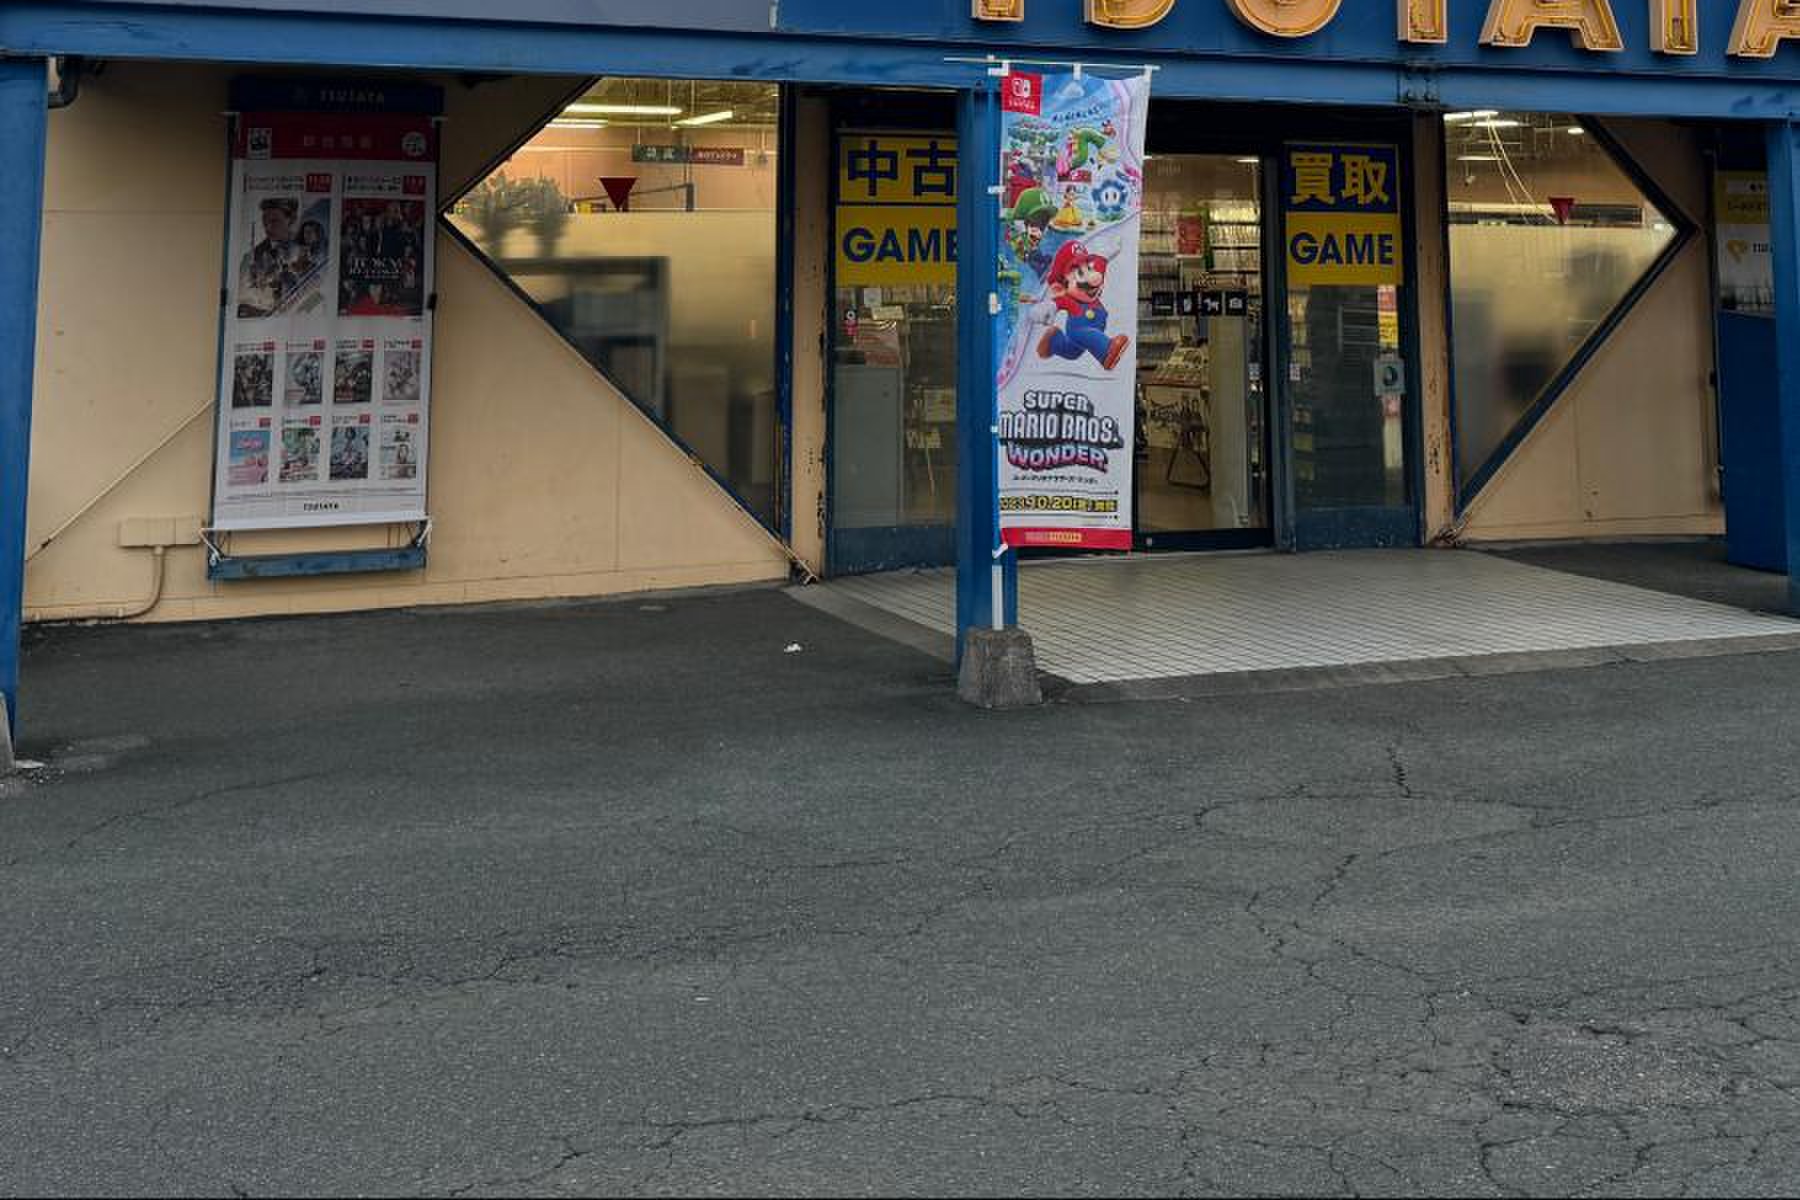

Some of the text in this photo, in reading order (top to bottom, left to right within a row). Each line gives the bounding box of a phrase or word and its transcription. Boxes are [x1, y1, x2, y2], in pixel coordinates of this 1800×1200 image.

[848, 139, 959, 197] 中古
[1290, 152, 1389, 205] 買取
[842, 226, 959, 263] GAME
[1289, 231, 1394, 265] GAME
[1024, 389, 1091, 412] SUPER
[999, 410, 1058, 440] MARIO
[1007, 442, 1107, 471] WONDER
